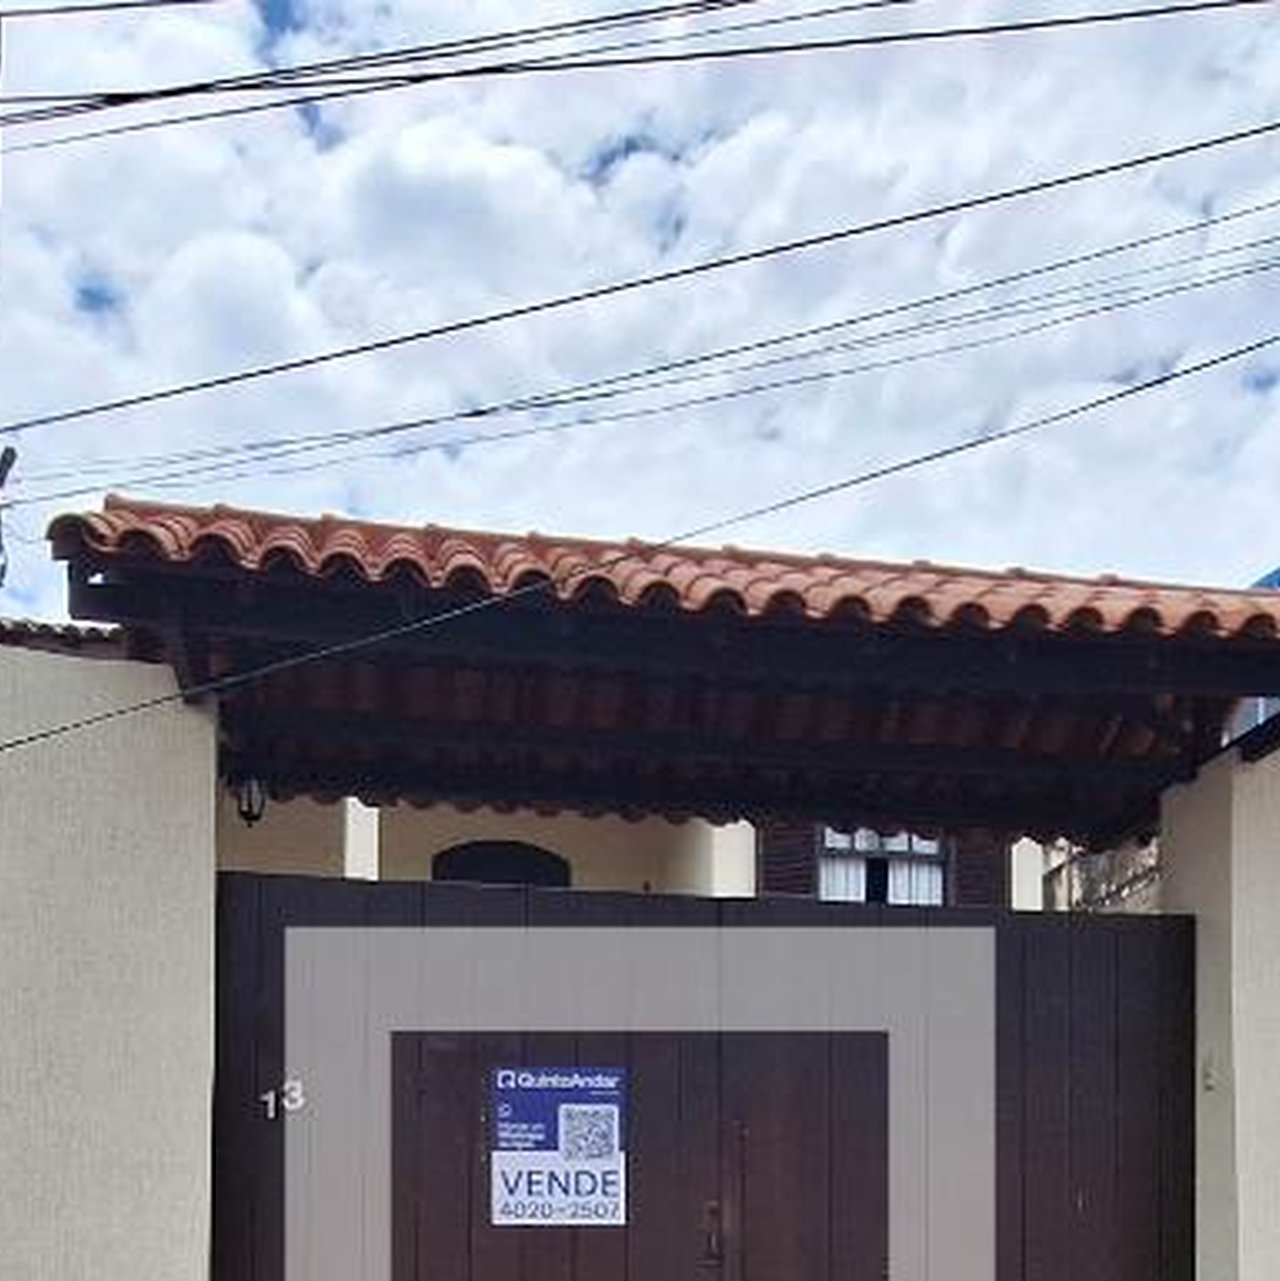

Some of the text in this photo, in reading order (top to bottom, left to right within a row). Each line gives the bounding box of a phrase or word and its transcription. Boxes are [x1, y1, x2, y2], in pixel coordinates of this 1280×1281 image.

[261, 1080, 305, 1118] 13
[500, 1170, 619, 1197] VENDE
[499, 1202, 620, 1219] 4020-2507
